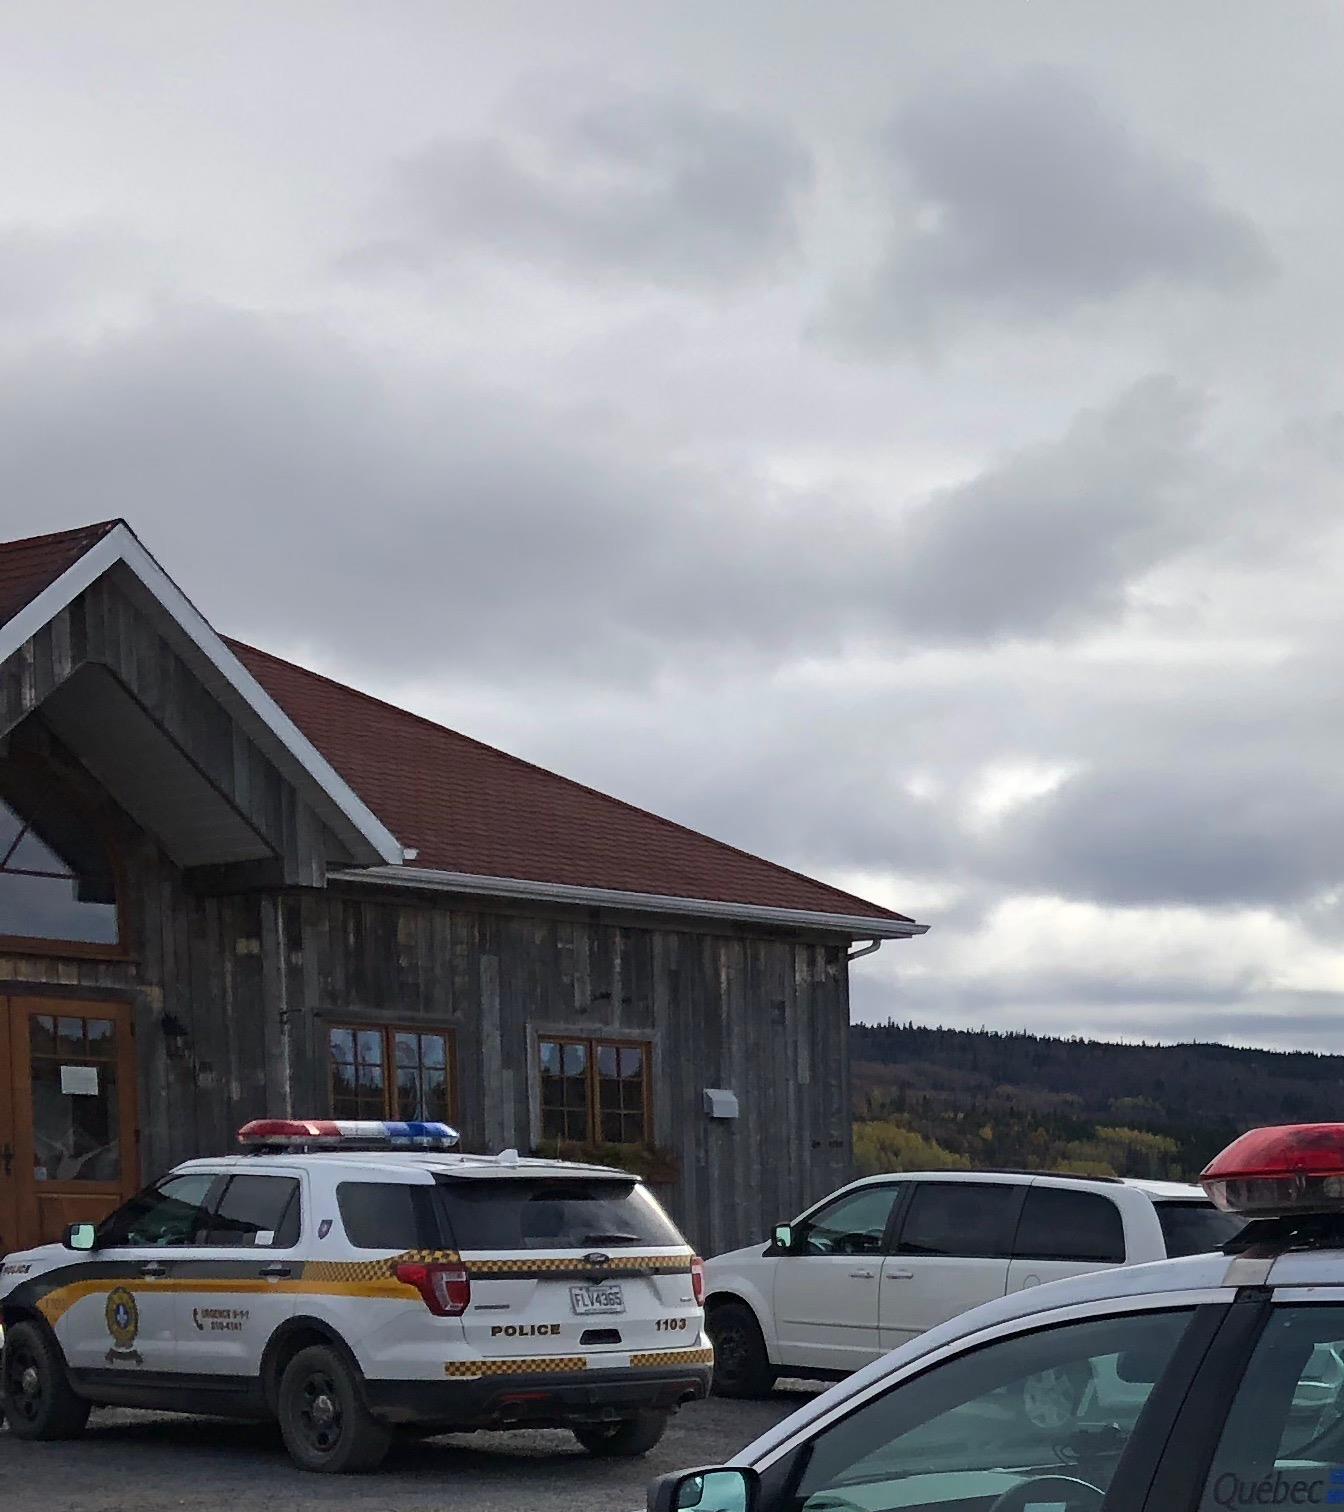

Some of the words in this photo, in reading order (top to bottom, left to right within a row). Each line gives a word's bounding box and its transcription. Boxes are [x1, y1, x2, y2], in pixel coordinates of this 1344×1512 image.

[491, 1323, 561, 1337] POLICE
[655, 1318, 687, 1331] 1103
[1213, 1470, 1324, 1511] Québec
